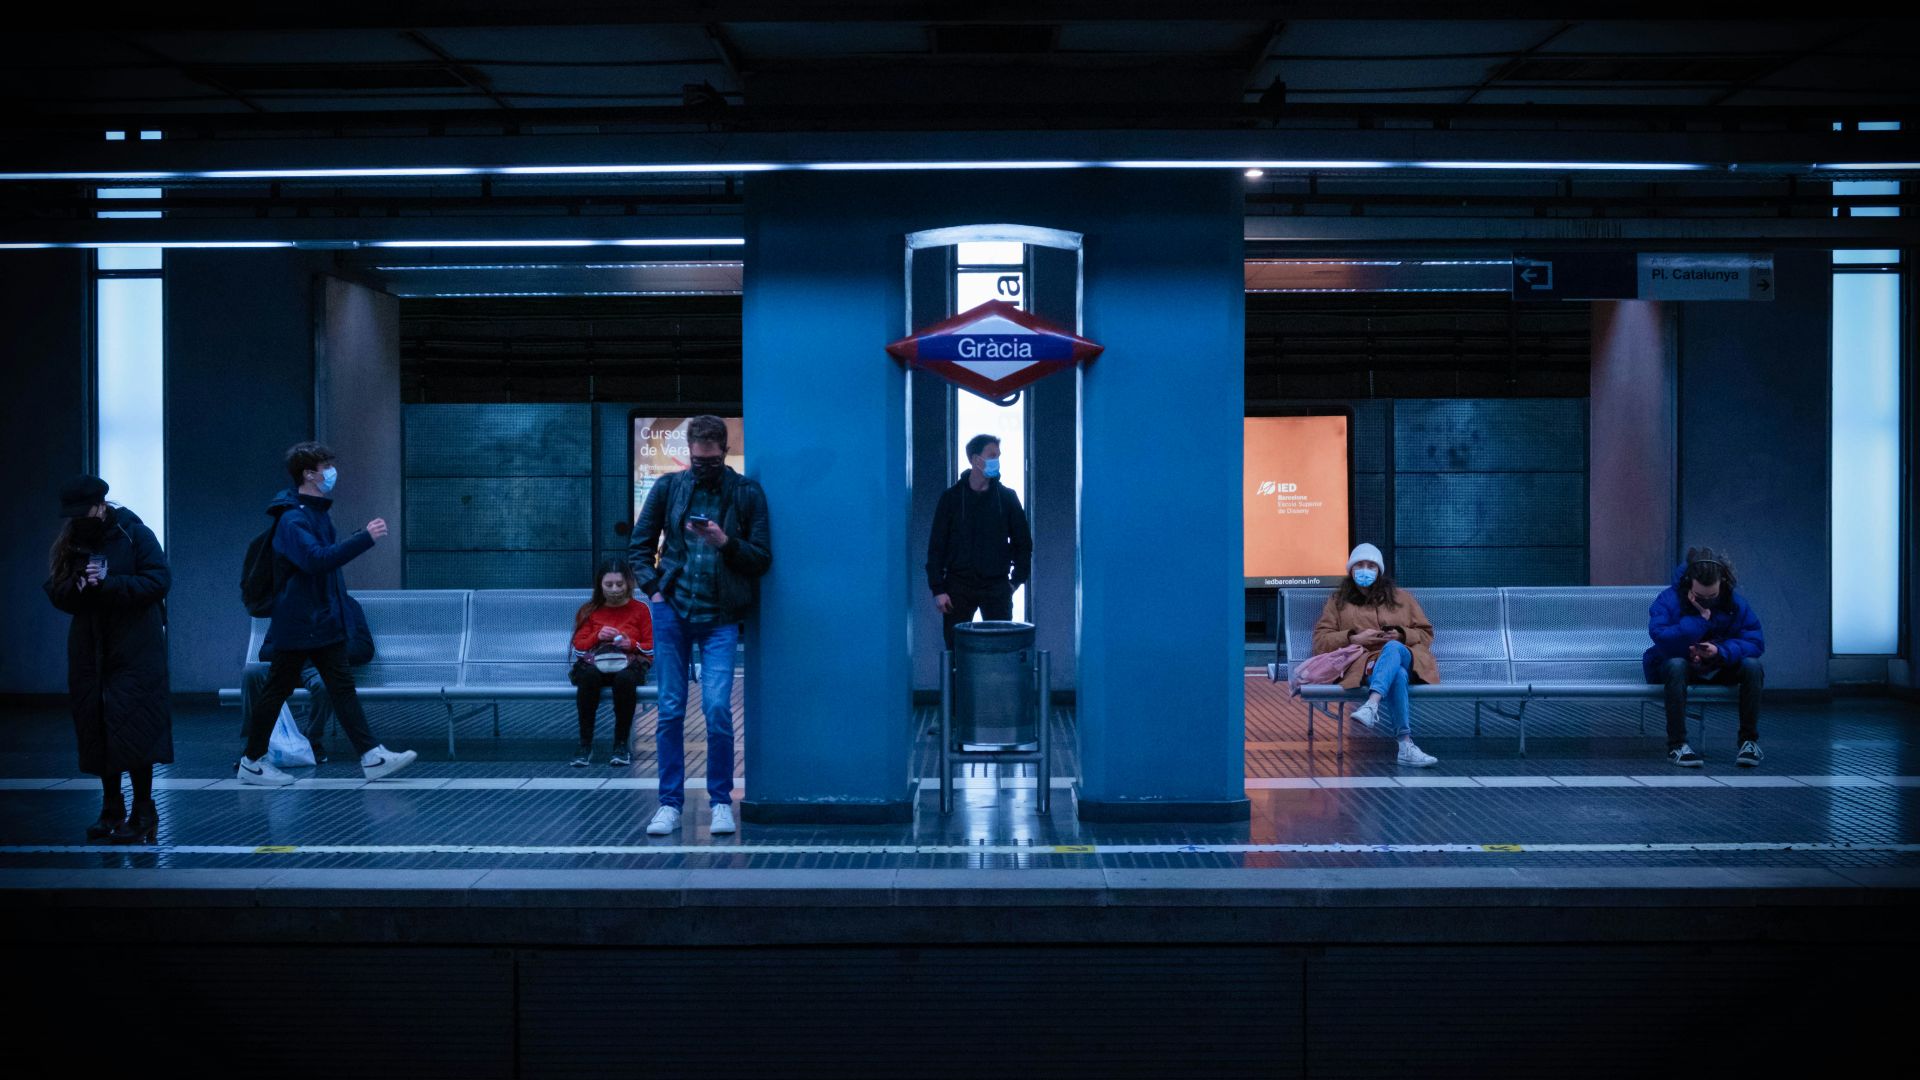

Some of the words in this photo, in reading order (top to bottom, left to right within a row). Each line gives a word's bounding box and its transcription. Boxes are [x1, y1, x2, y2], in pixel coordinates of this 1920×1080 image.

[1652, 268, 1668, 280] Pl.
[1672, 268, 1739, 282] Catalunya
[957, 337, 1032, 359] Gràcia
[640, 427, 687, 440] Cursos
[640, 444, 657, 456] de
[1277, 483, 1297, 493] IED
[1264, 577, 1321, 585] iedbarcelona.info
